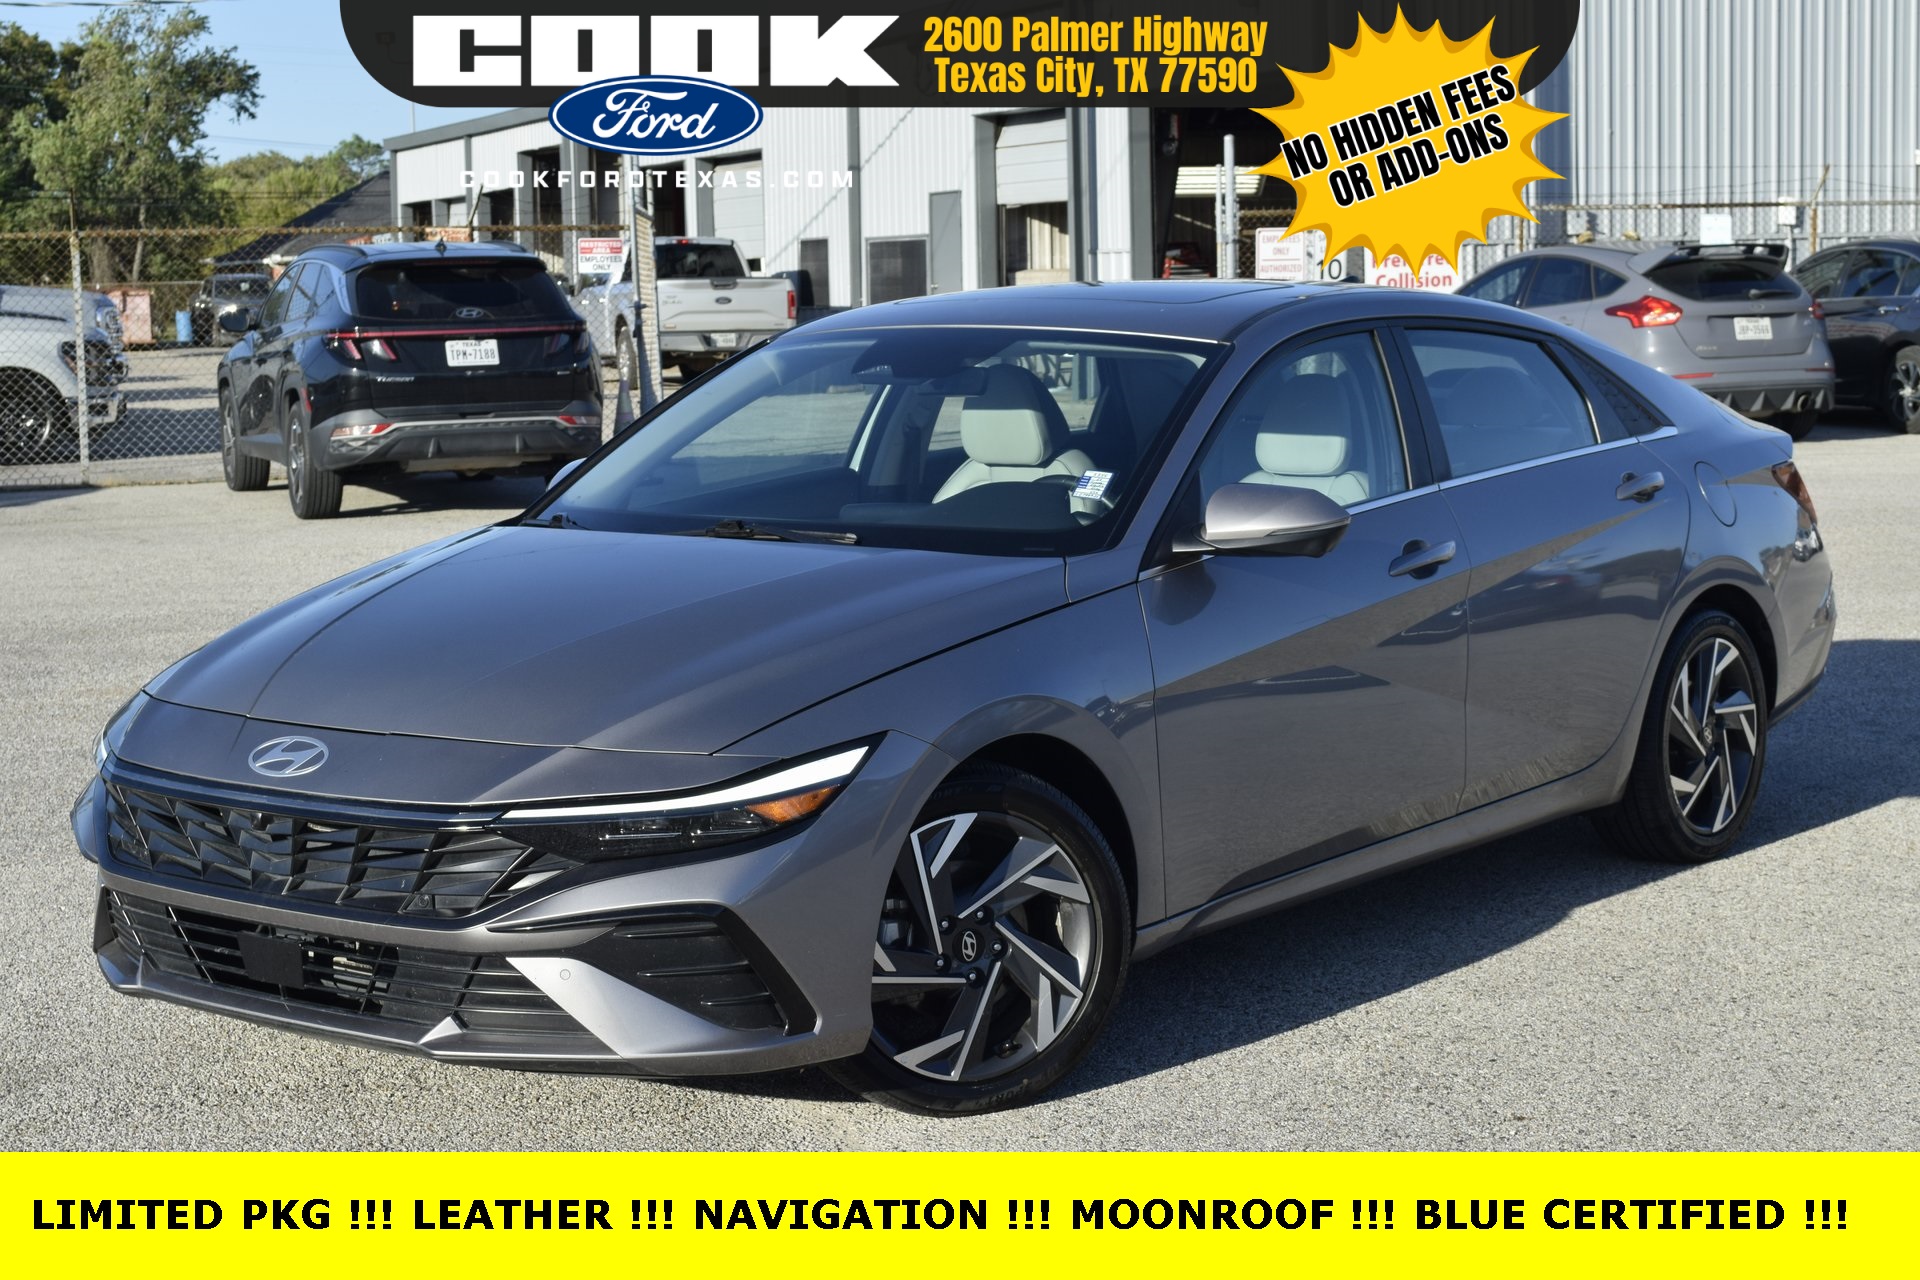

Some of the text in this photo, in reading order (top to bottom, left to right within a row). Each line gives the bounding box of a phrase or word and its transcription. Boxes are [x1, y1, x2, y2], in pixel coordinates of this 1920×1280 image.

[1272, 247, 1290, 255] ONLY
[580, 255, 623, 263] EMPLOYEES
[1260, 264, 1303, 273] AUTHORIZED
[1316, 258, 1342, 280] 10
[1376, 271, 1452, 288] Collision
